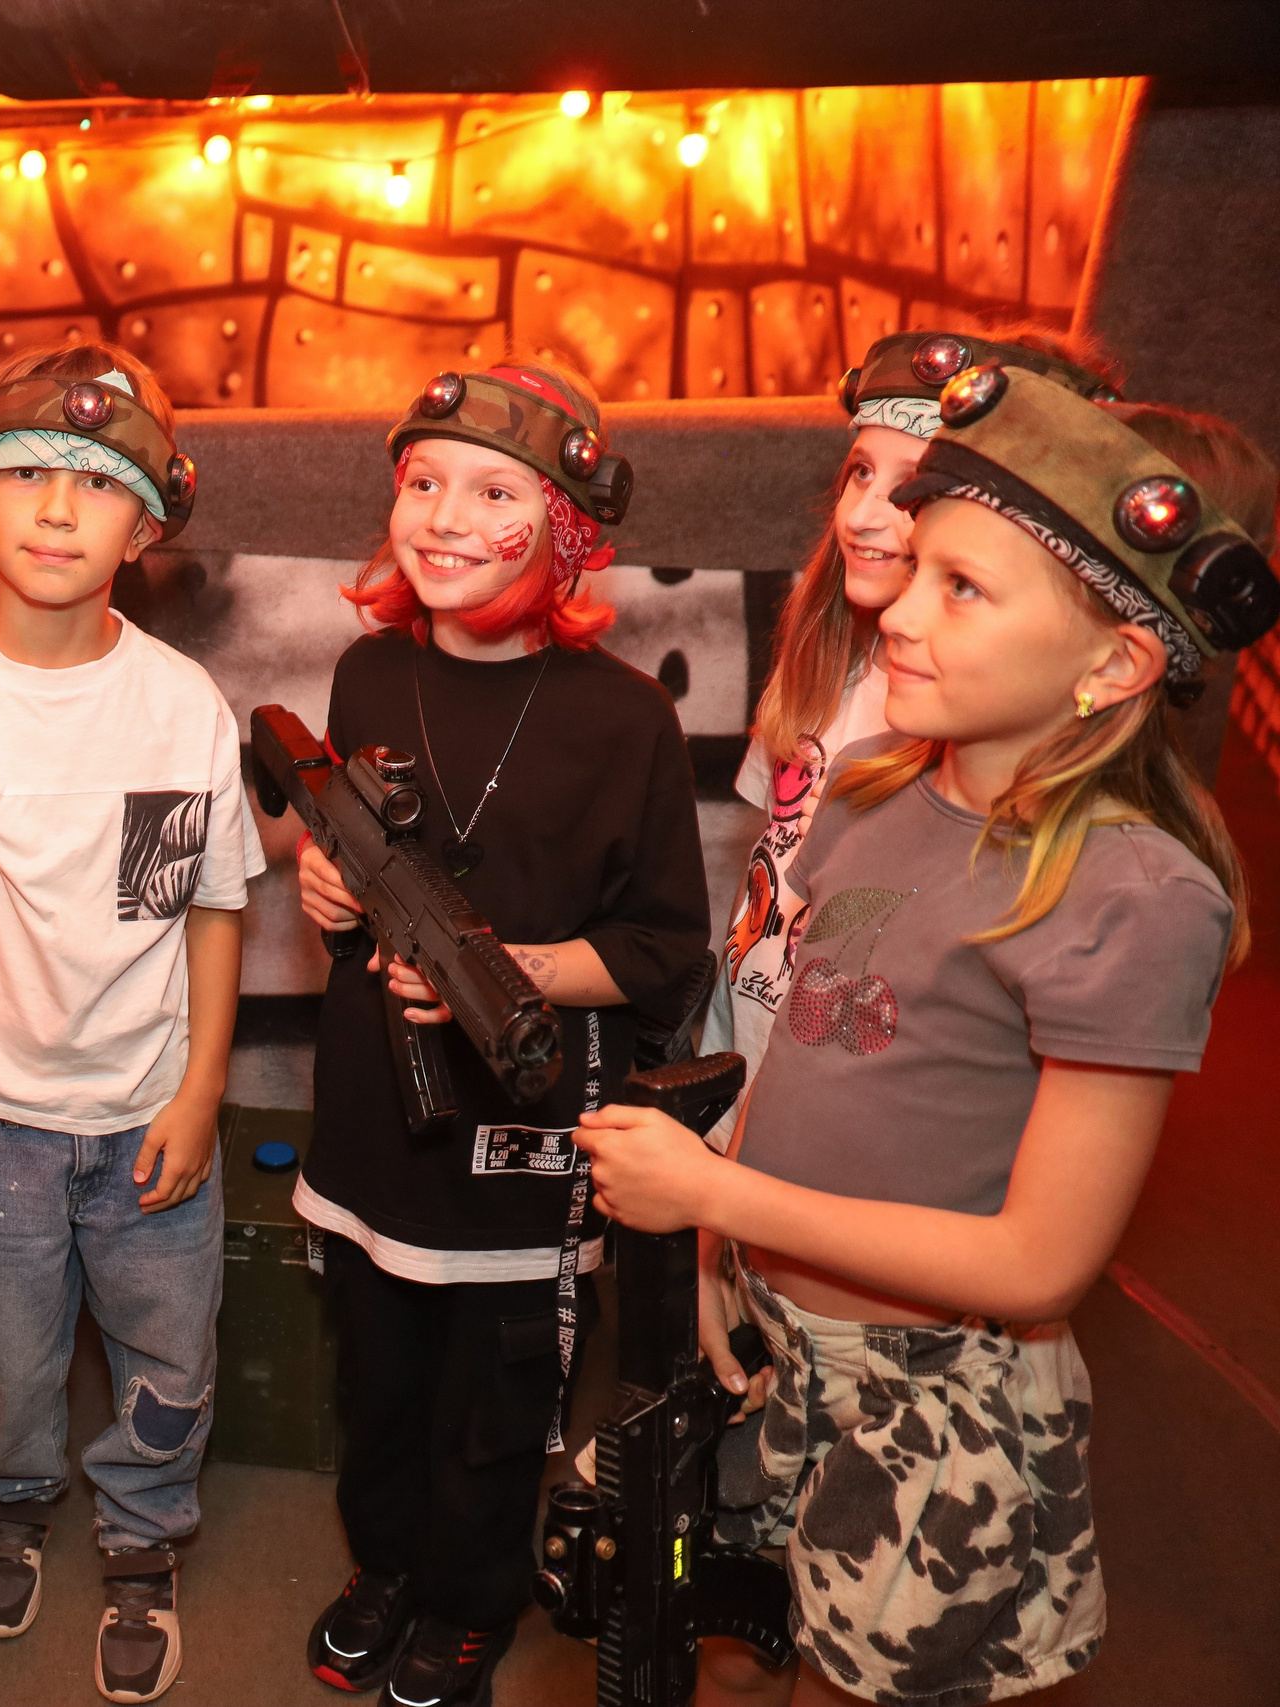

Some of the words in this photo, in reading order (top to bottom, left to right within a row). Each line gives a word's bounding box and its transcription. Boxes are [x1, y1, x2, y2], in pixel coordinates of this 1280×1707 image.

[742, 977, 783, 1006] SEVEN
[587, 1011, 601, 1069] REPOST
[493, 1132, 508, 1143] B13
[541, 1146, 560, 1154] SPORT
[489, 1149, 509, 1160] 4.20
[490, 1160, 506, 1168] SPORT
[567, 1178, 588, 1225] REPOST
[558, 1250, 577, 1299] REPOST
[558, 1325, 576, 1378] REPOST
